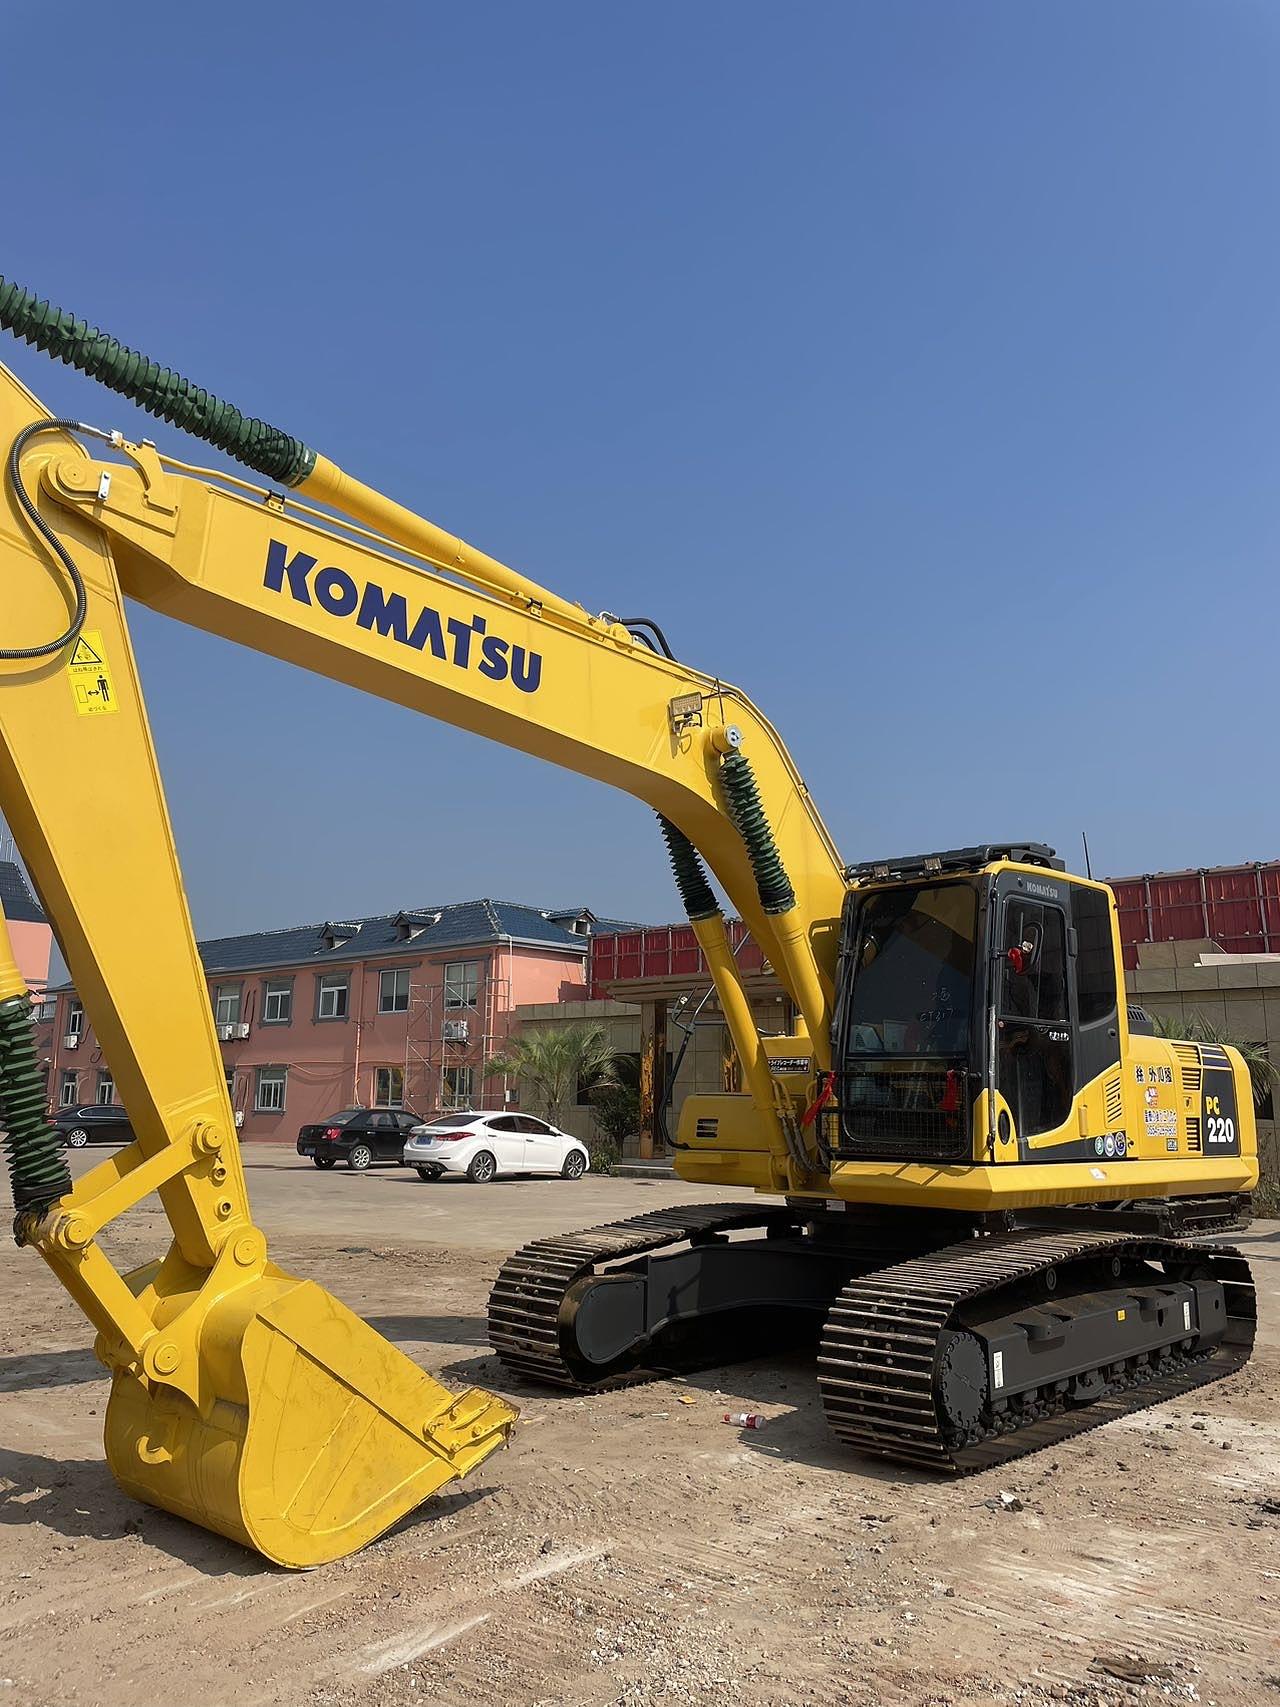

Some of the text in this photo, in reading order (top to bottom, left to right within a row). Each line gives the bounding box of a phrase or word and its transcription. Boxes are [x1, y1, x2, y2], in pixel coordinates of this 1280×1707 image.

[263, 538, 542, 693] KOMATSU
[1026, 881, 1058, 898] KOMATSU
[1205, 1096, 1220, 1115] PC
[1207, 1117, 1235, 1143] 220
